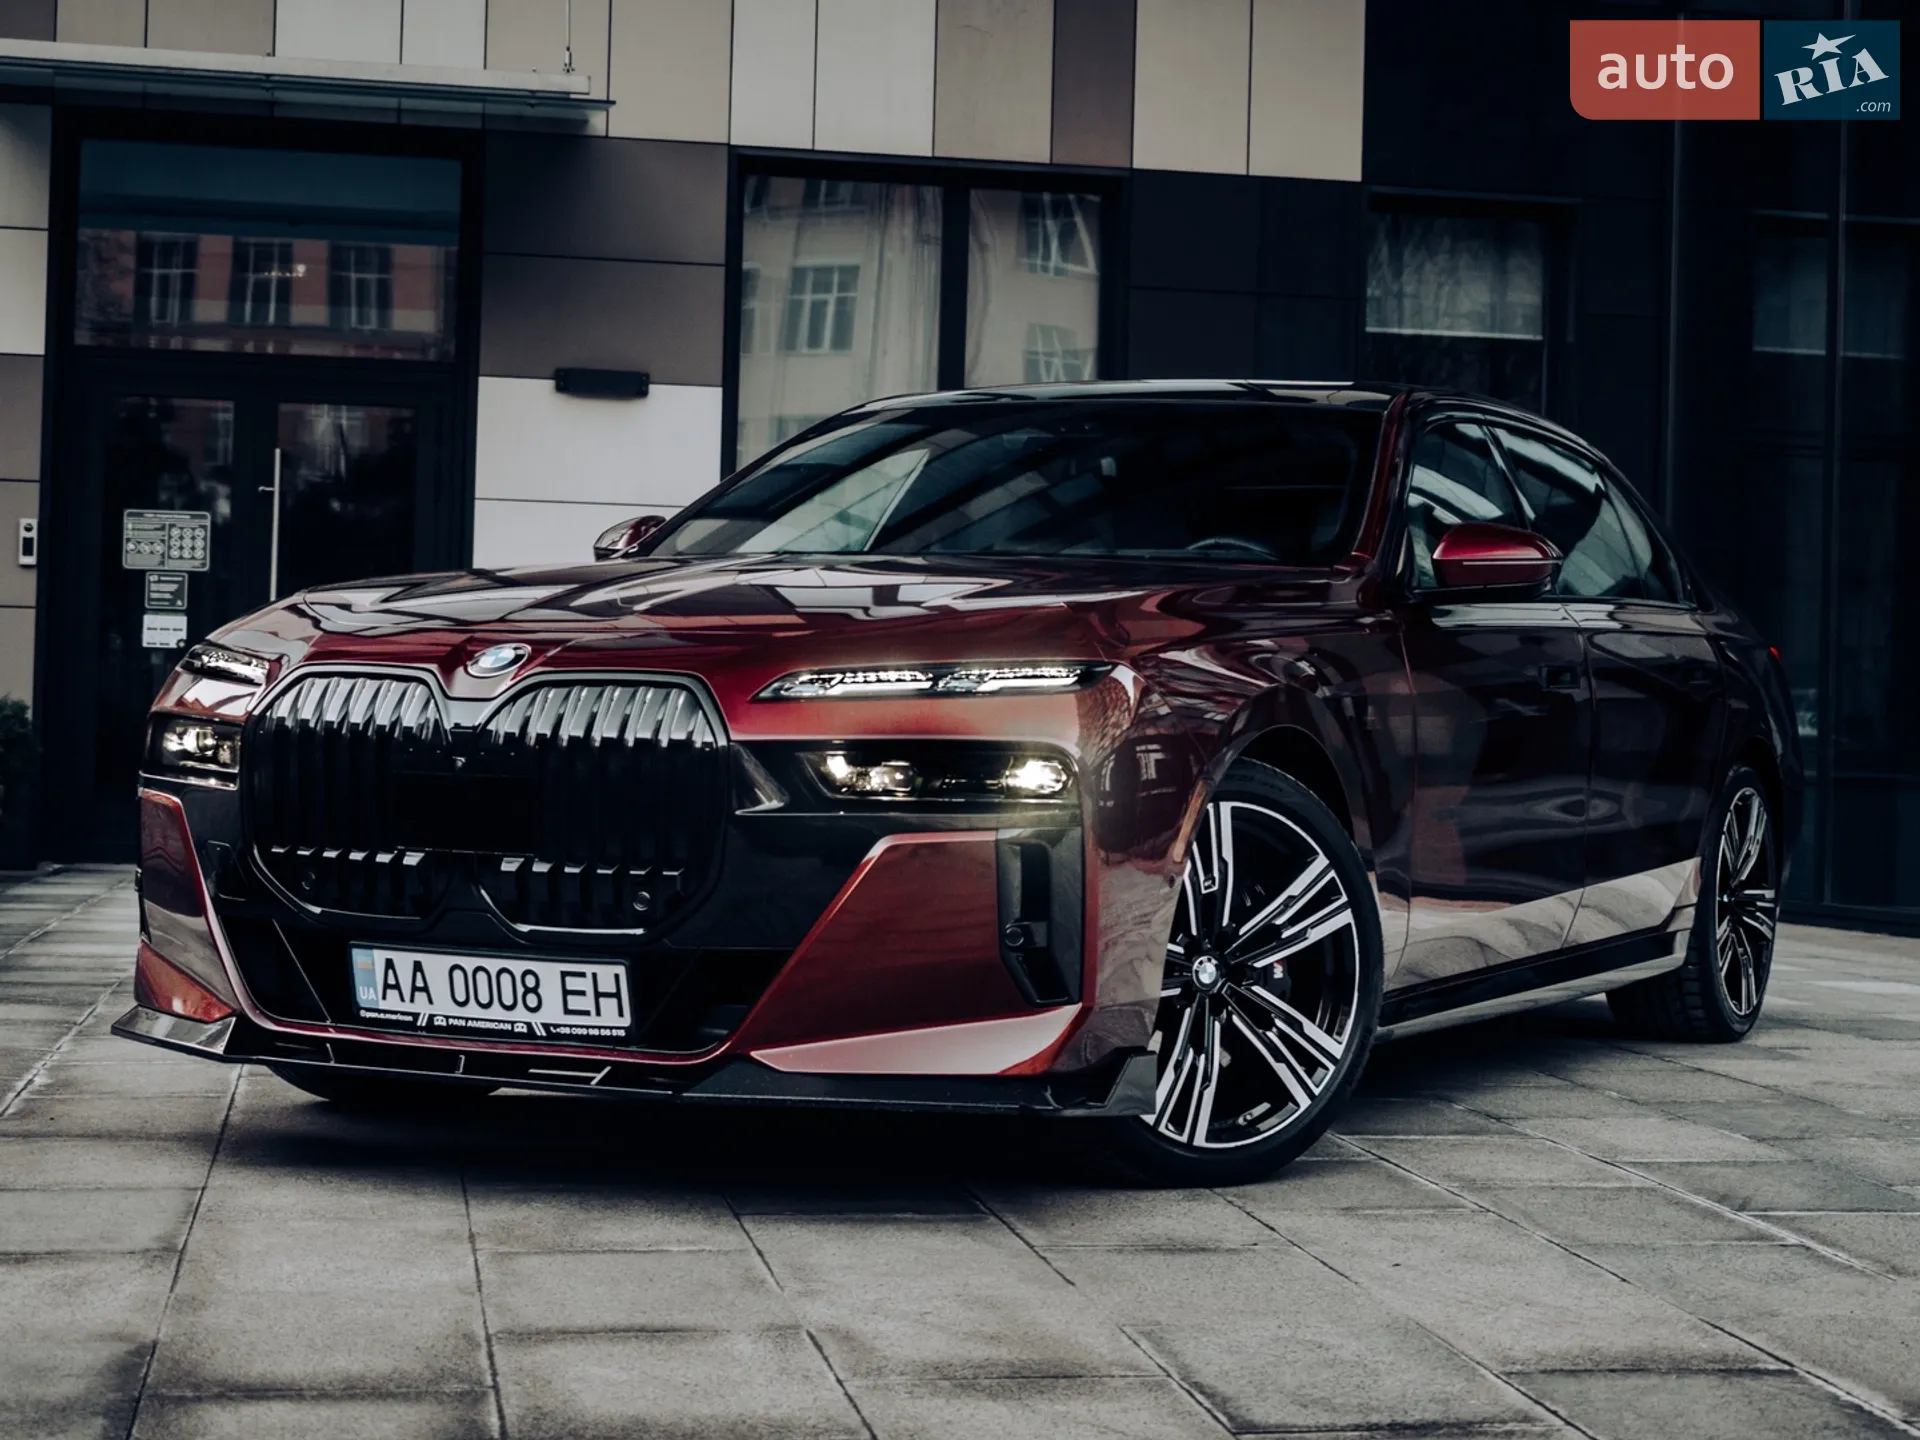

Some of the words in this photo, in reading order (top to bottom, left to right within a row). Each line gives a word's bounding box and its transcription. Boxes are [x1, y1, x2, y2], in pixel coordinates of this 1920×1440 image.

[359, 985, 377, 1001] UA
[381, 957, 434, 1005] AA
[448, 963, 543, 1013] 0008
[560, 970, 625, 1018] EH
[448, 1018, 466, 1027] PAN
[466, 1020, 512, 1031] AMERICAN
